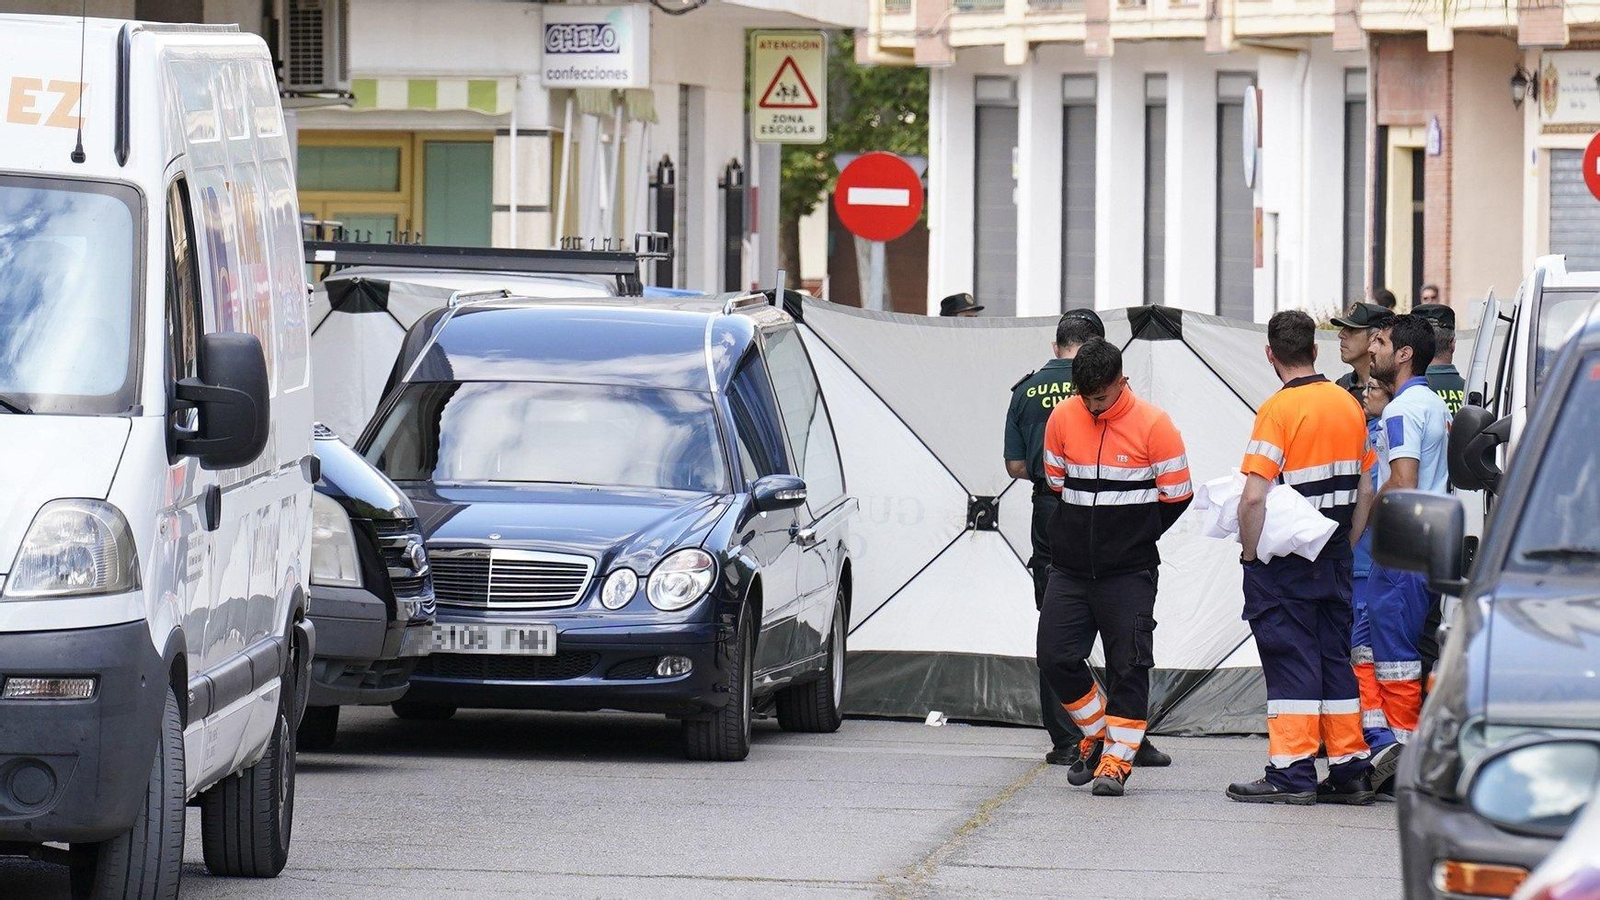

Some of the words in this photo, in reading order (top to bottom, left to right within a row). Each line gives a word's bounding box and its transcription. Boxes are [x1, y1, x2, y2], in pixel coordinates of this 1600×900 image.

[545, 25, 617, 51] CHELO
[759, 40, 820, 50] ATENCION
[546, 66, 628, 80] confecciones
[773, 114, 804, 123] ZONA
[761, 125, 815, 134] ESCOLAR
[1026, 382, 1076, 398] GUAR
[1116, 454, 1128, 463] TES
